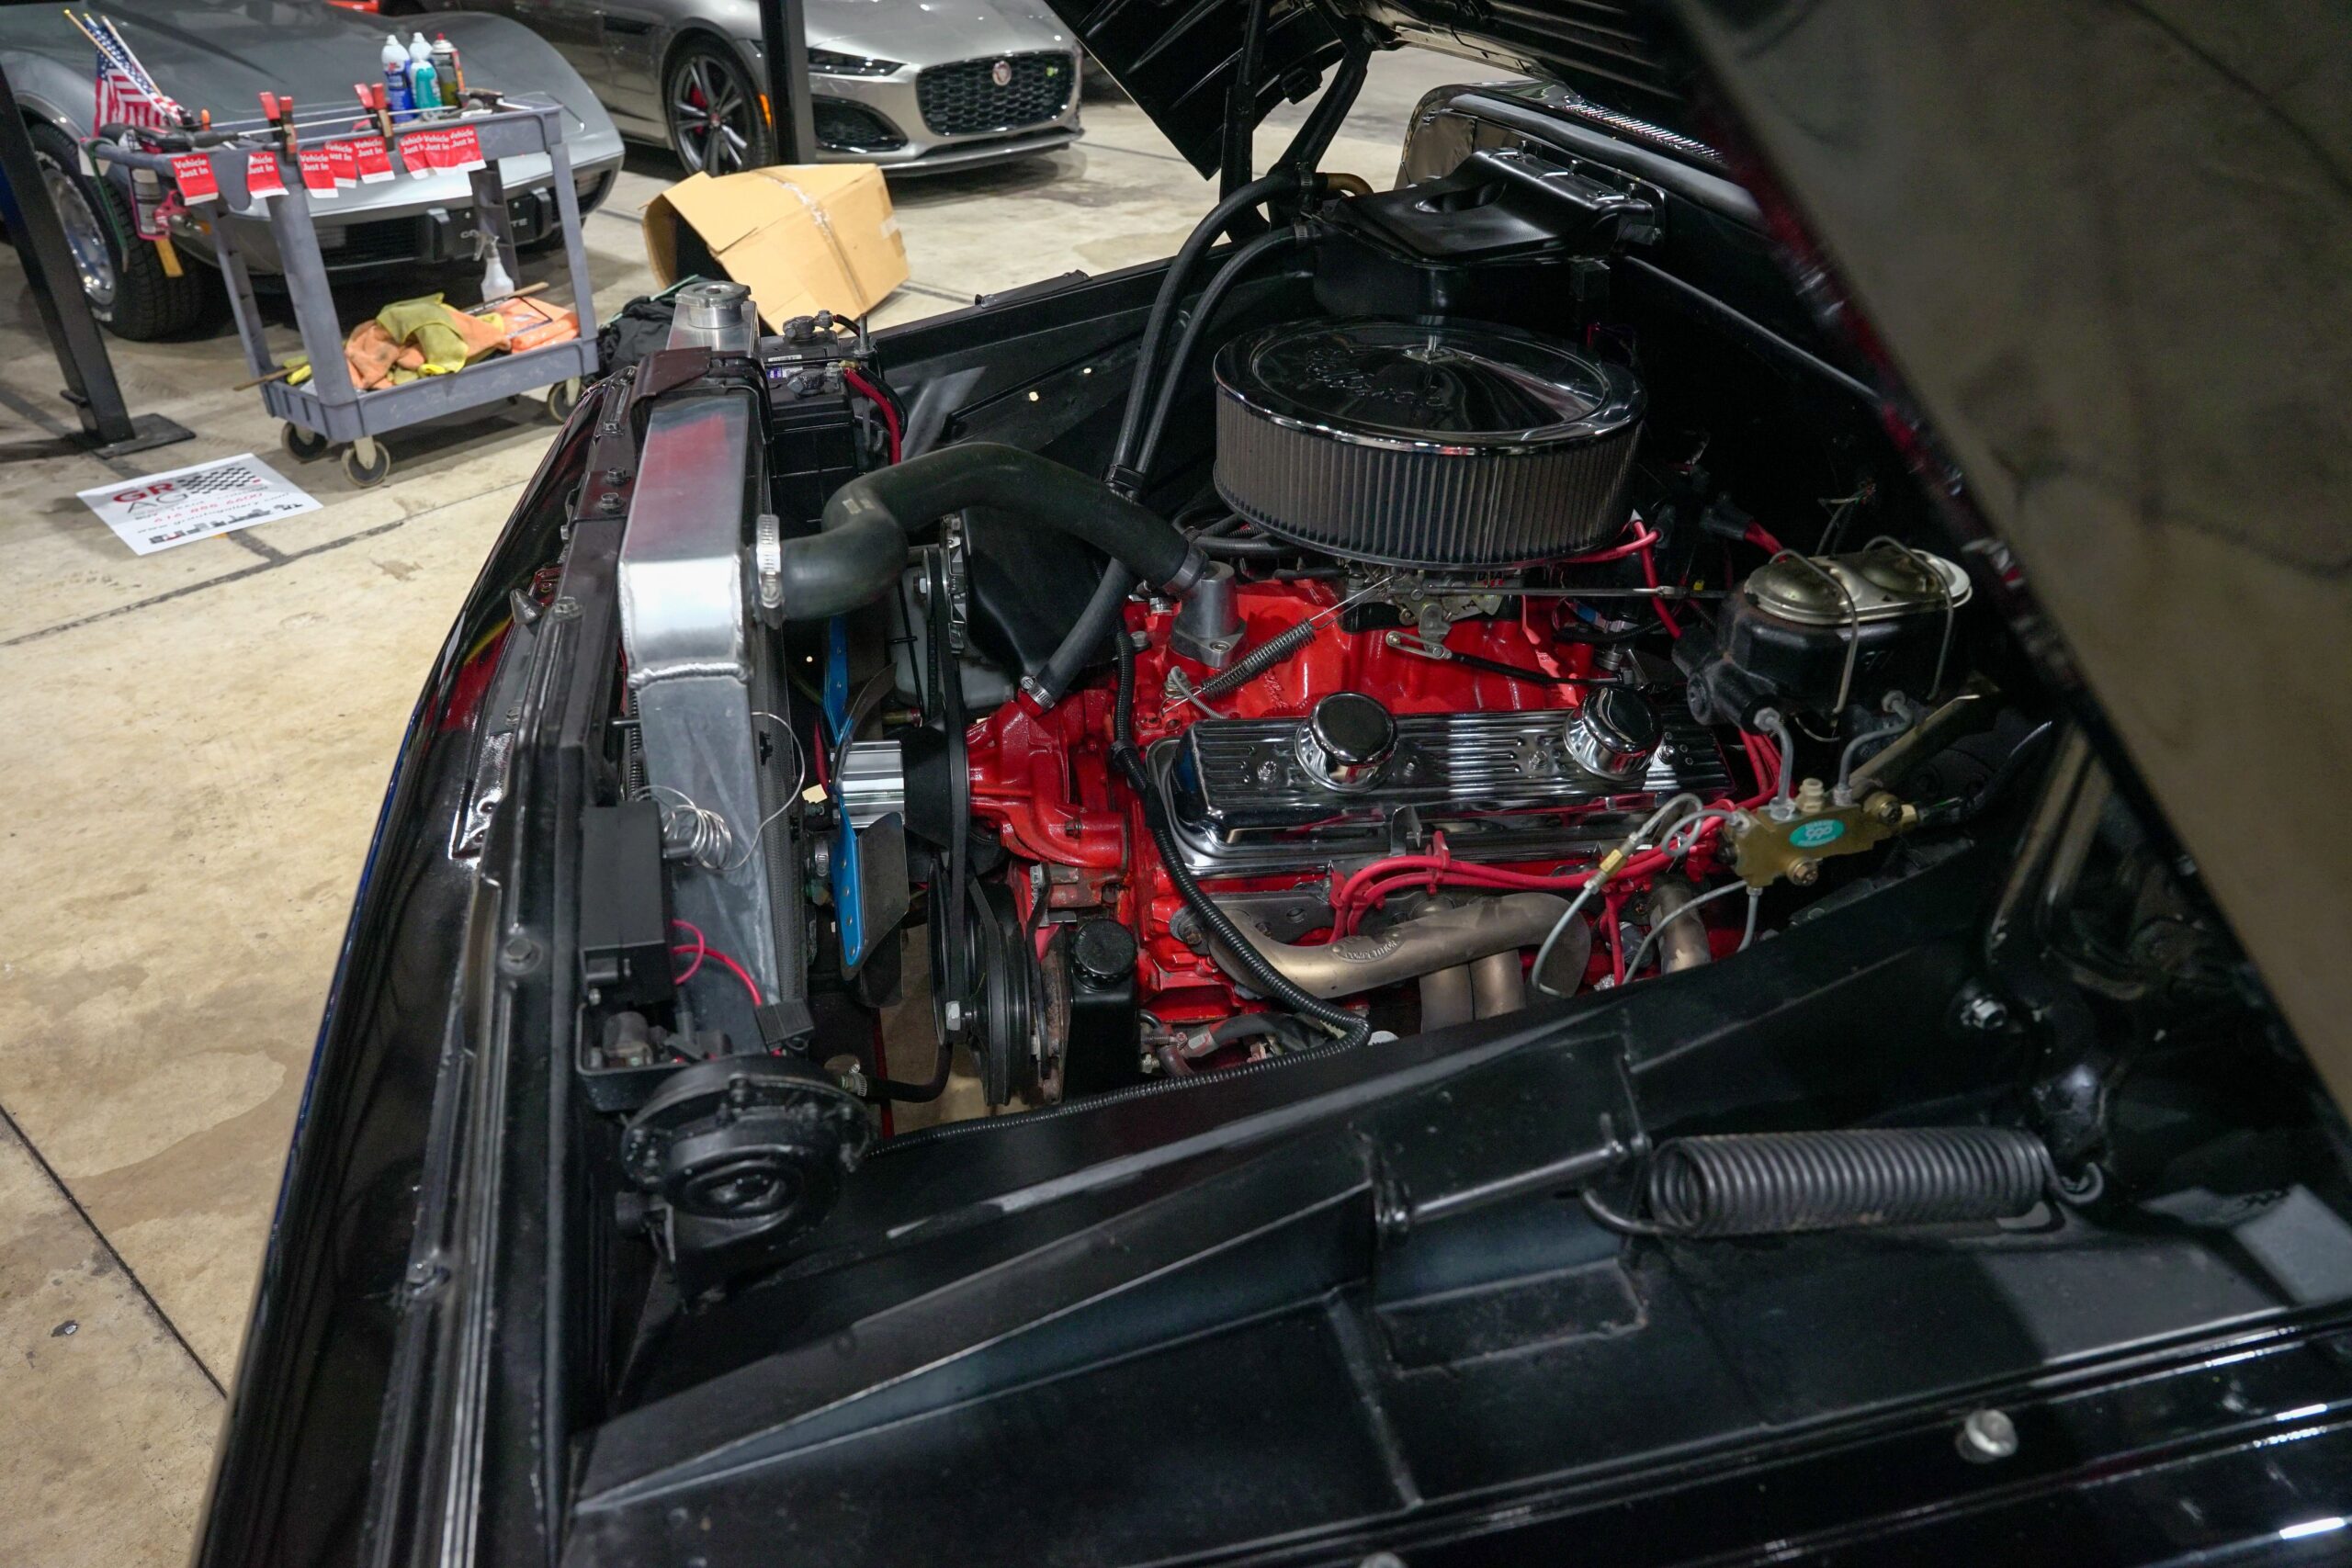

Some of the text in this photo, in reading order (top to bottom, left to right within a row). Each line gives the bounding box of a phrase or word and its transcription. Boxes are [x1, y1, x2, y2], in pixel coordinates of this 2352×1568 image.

[424, 133, 449, 142] Vehicle
[354, 139, 383, 148] Vehicle
[344, 152, 353, 161] In
[358, 149, 374, 157] Just
[300, 153, 329, 163] Vehicle
[174, 158, 208, 169] Vehicle
[180, 166, 209, 178] Just In
[265, 164, 275, 173] In
[113, 483, 175, 502] GR
[127, 493, 188, 513] AG
